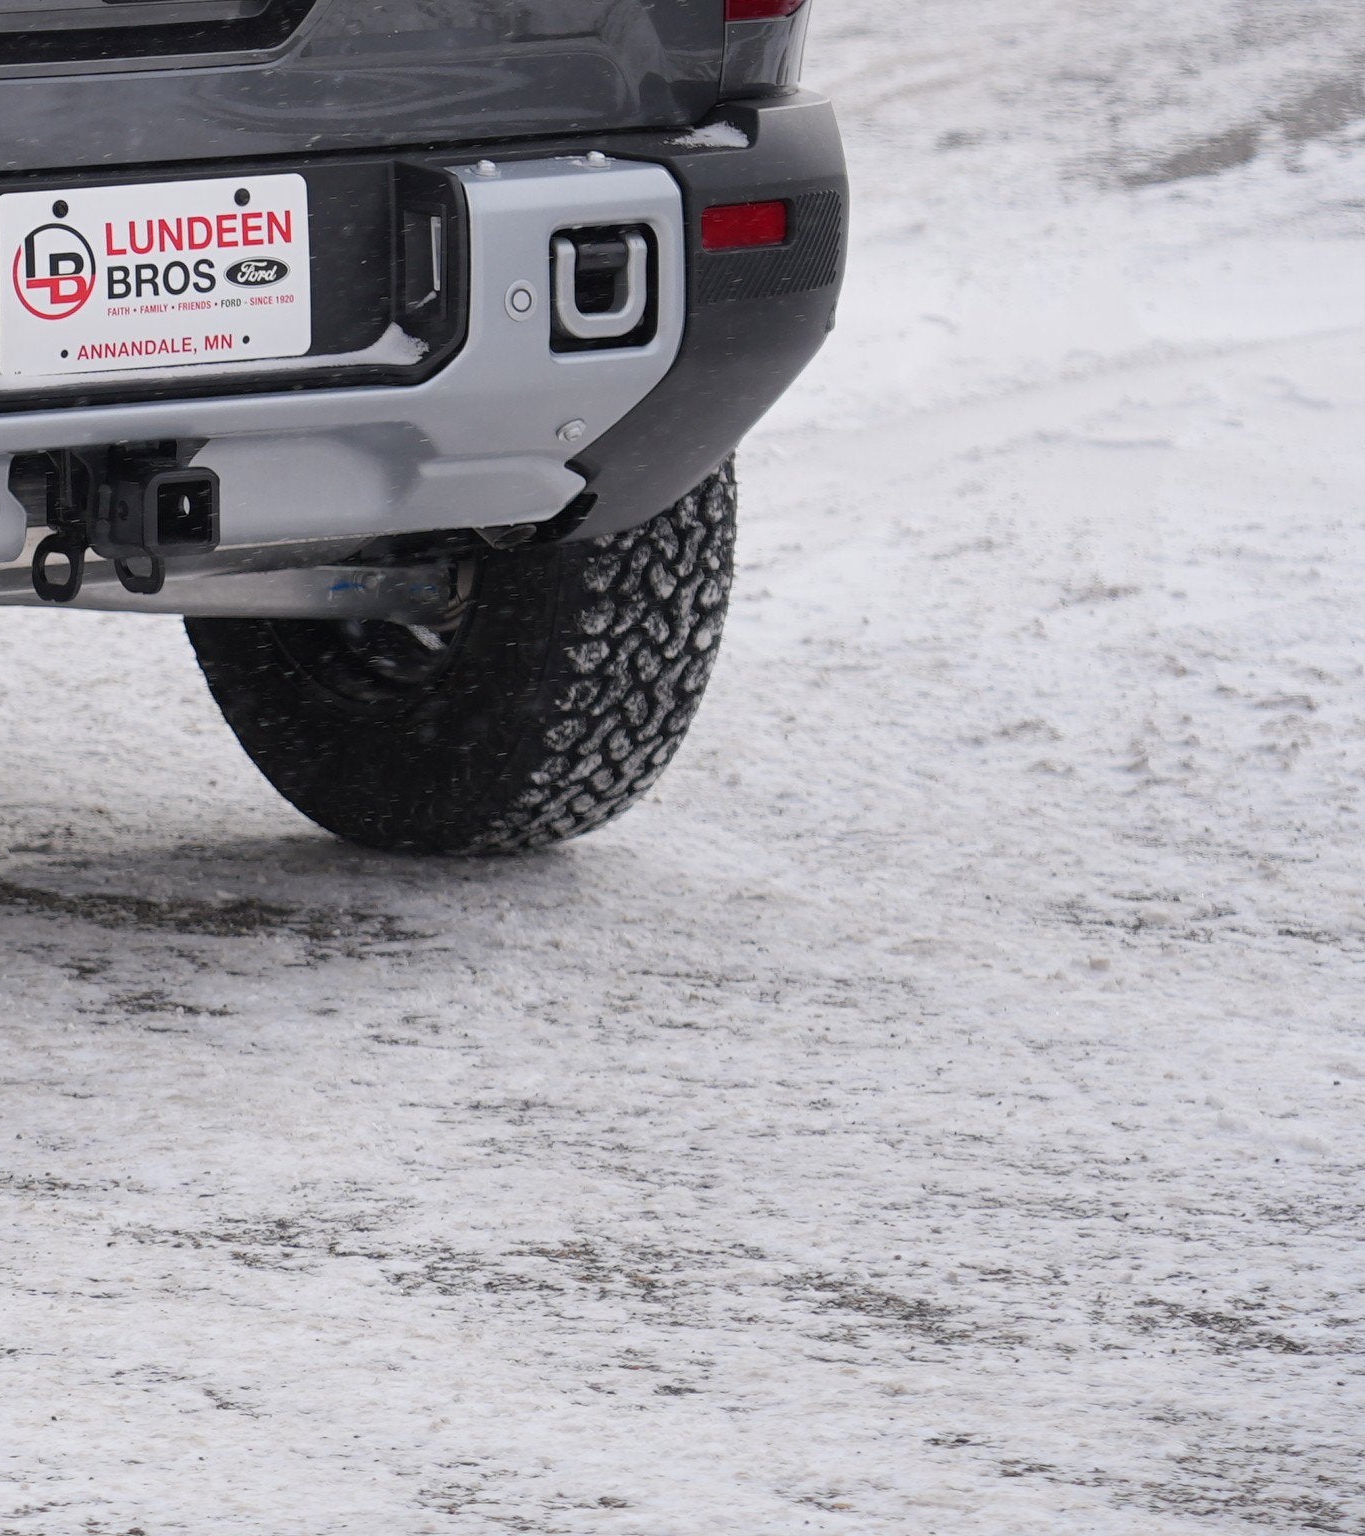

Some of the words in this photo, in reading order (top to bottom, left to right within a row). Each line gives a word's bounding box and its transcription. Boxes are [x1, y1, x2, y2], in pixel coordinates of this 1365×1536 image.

[105, 210, 293, 256] LUNDEEN
[107, 258, 217, 300] BROS
[107, 307, 131, 317] FAITH
[139, 304, 169, 314] FAMILY
[177, 301, 212, 312] FRIENDS
[220, 298, 242, 308] FORD
[249, 296, 273, 307] SINCE
[275, 294, 295, 305] 1920
[76, 337, 198, 361] ANNANDALE,
[204, 333, 234, 351] MN
